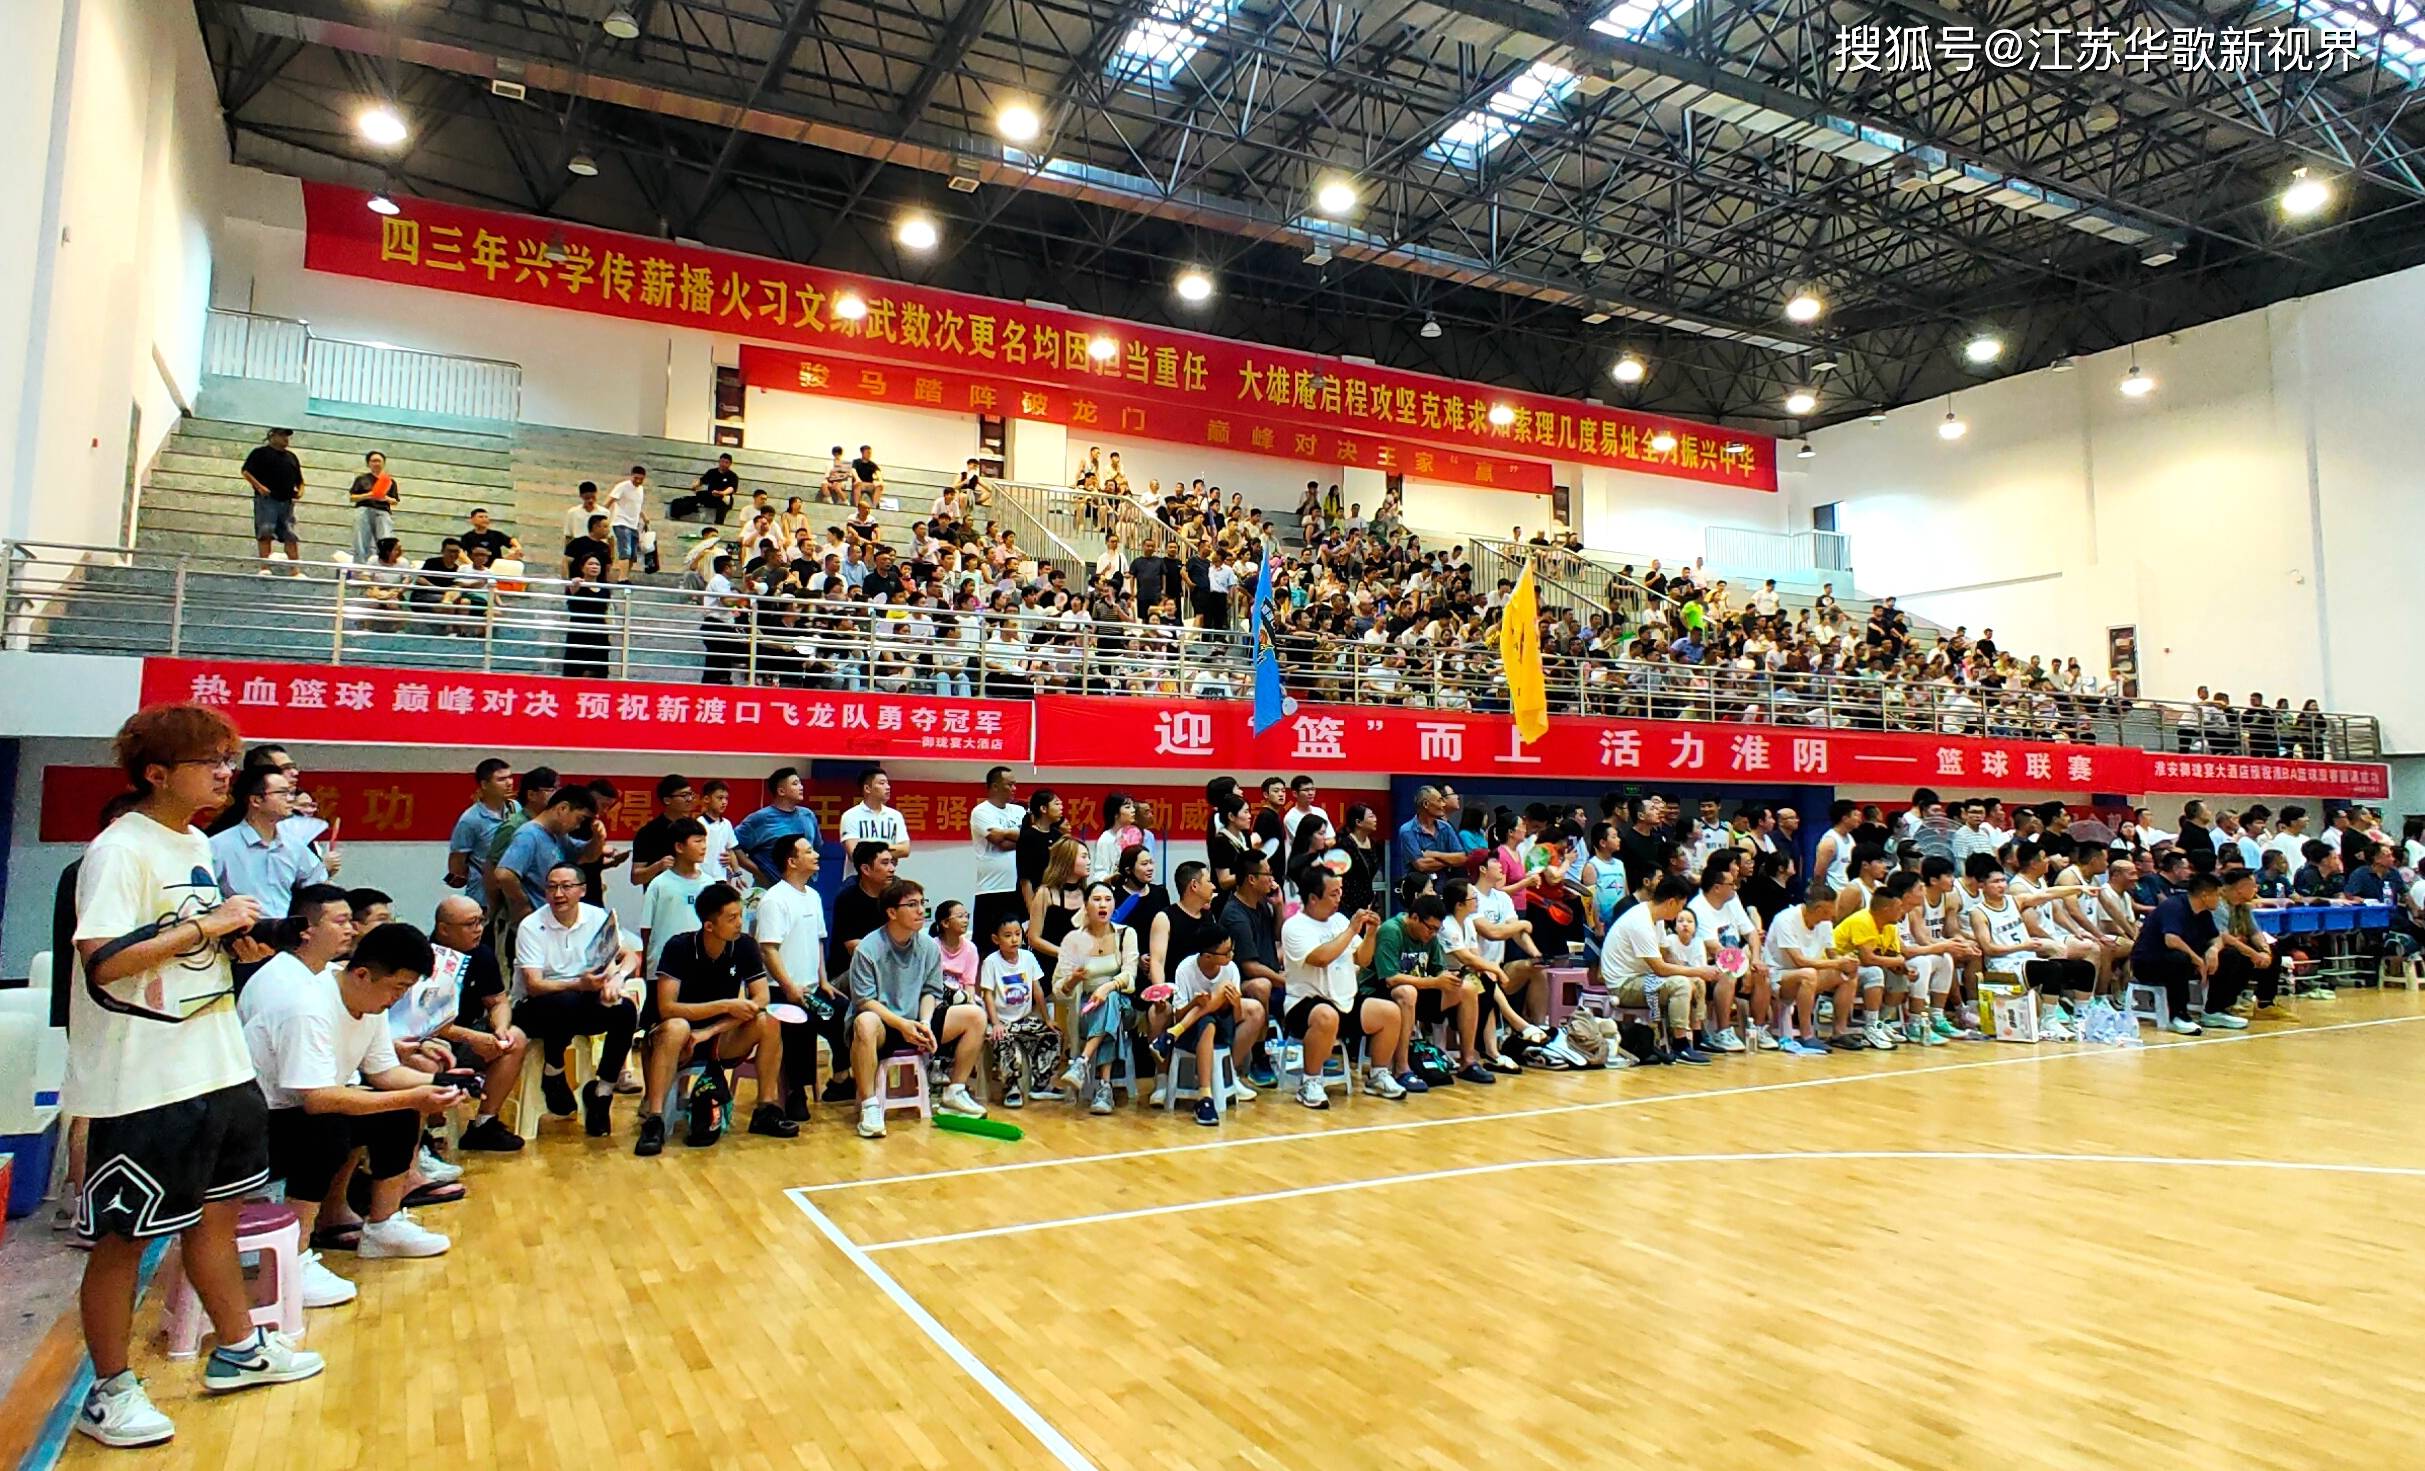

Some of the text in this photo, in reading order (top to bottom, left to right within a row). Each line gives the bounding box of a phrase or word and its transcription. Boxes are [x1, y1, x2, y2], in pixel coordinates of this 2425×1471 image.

[799, 361, 1146, 431] 骏马踏阵破龙门
[190, 673, 1004, 735] 热血篮球 巅峰对决 预祝新渡口飞龙队勇夺冠军
[859, 817, 898, 844] ITALIA
[2010, 932, 2022, 944] 5
